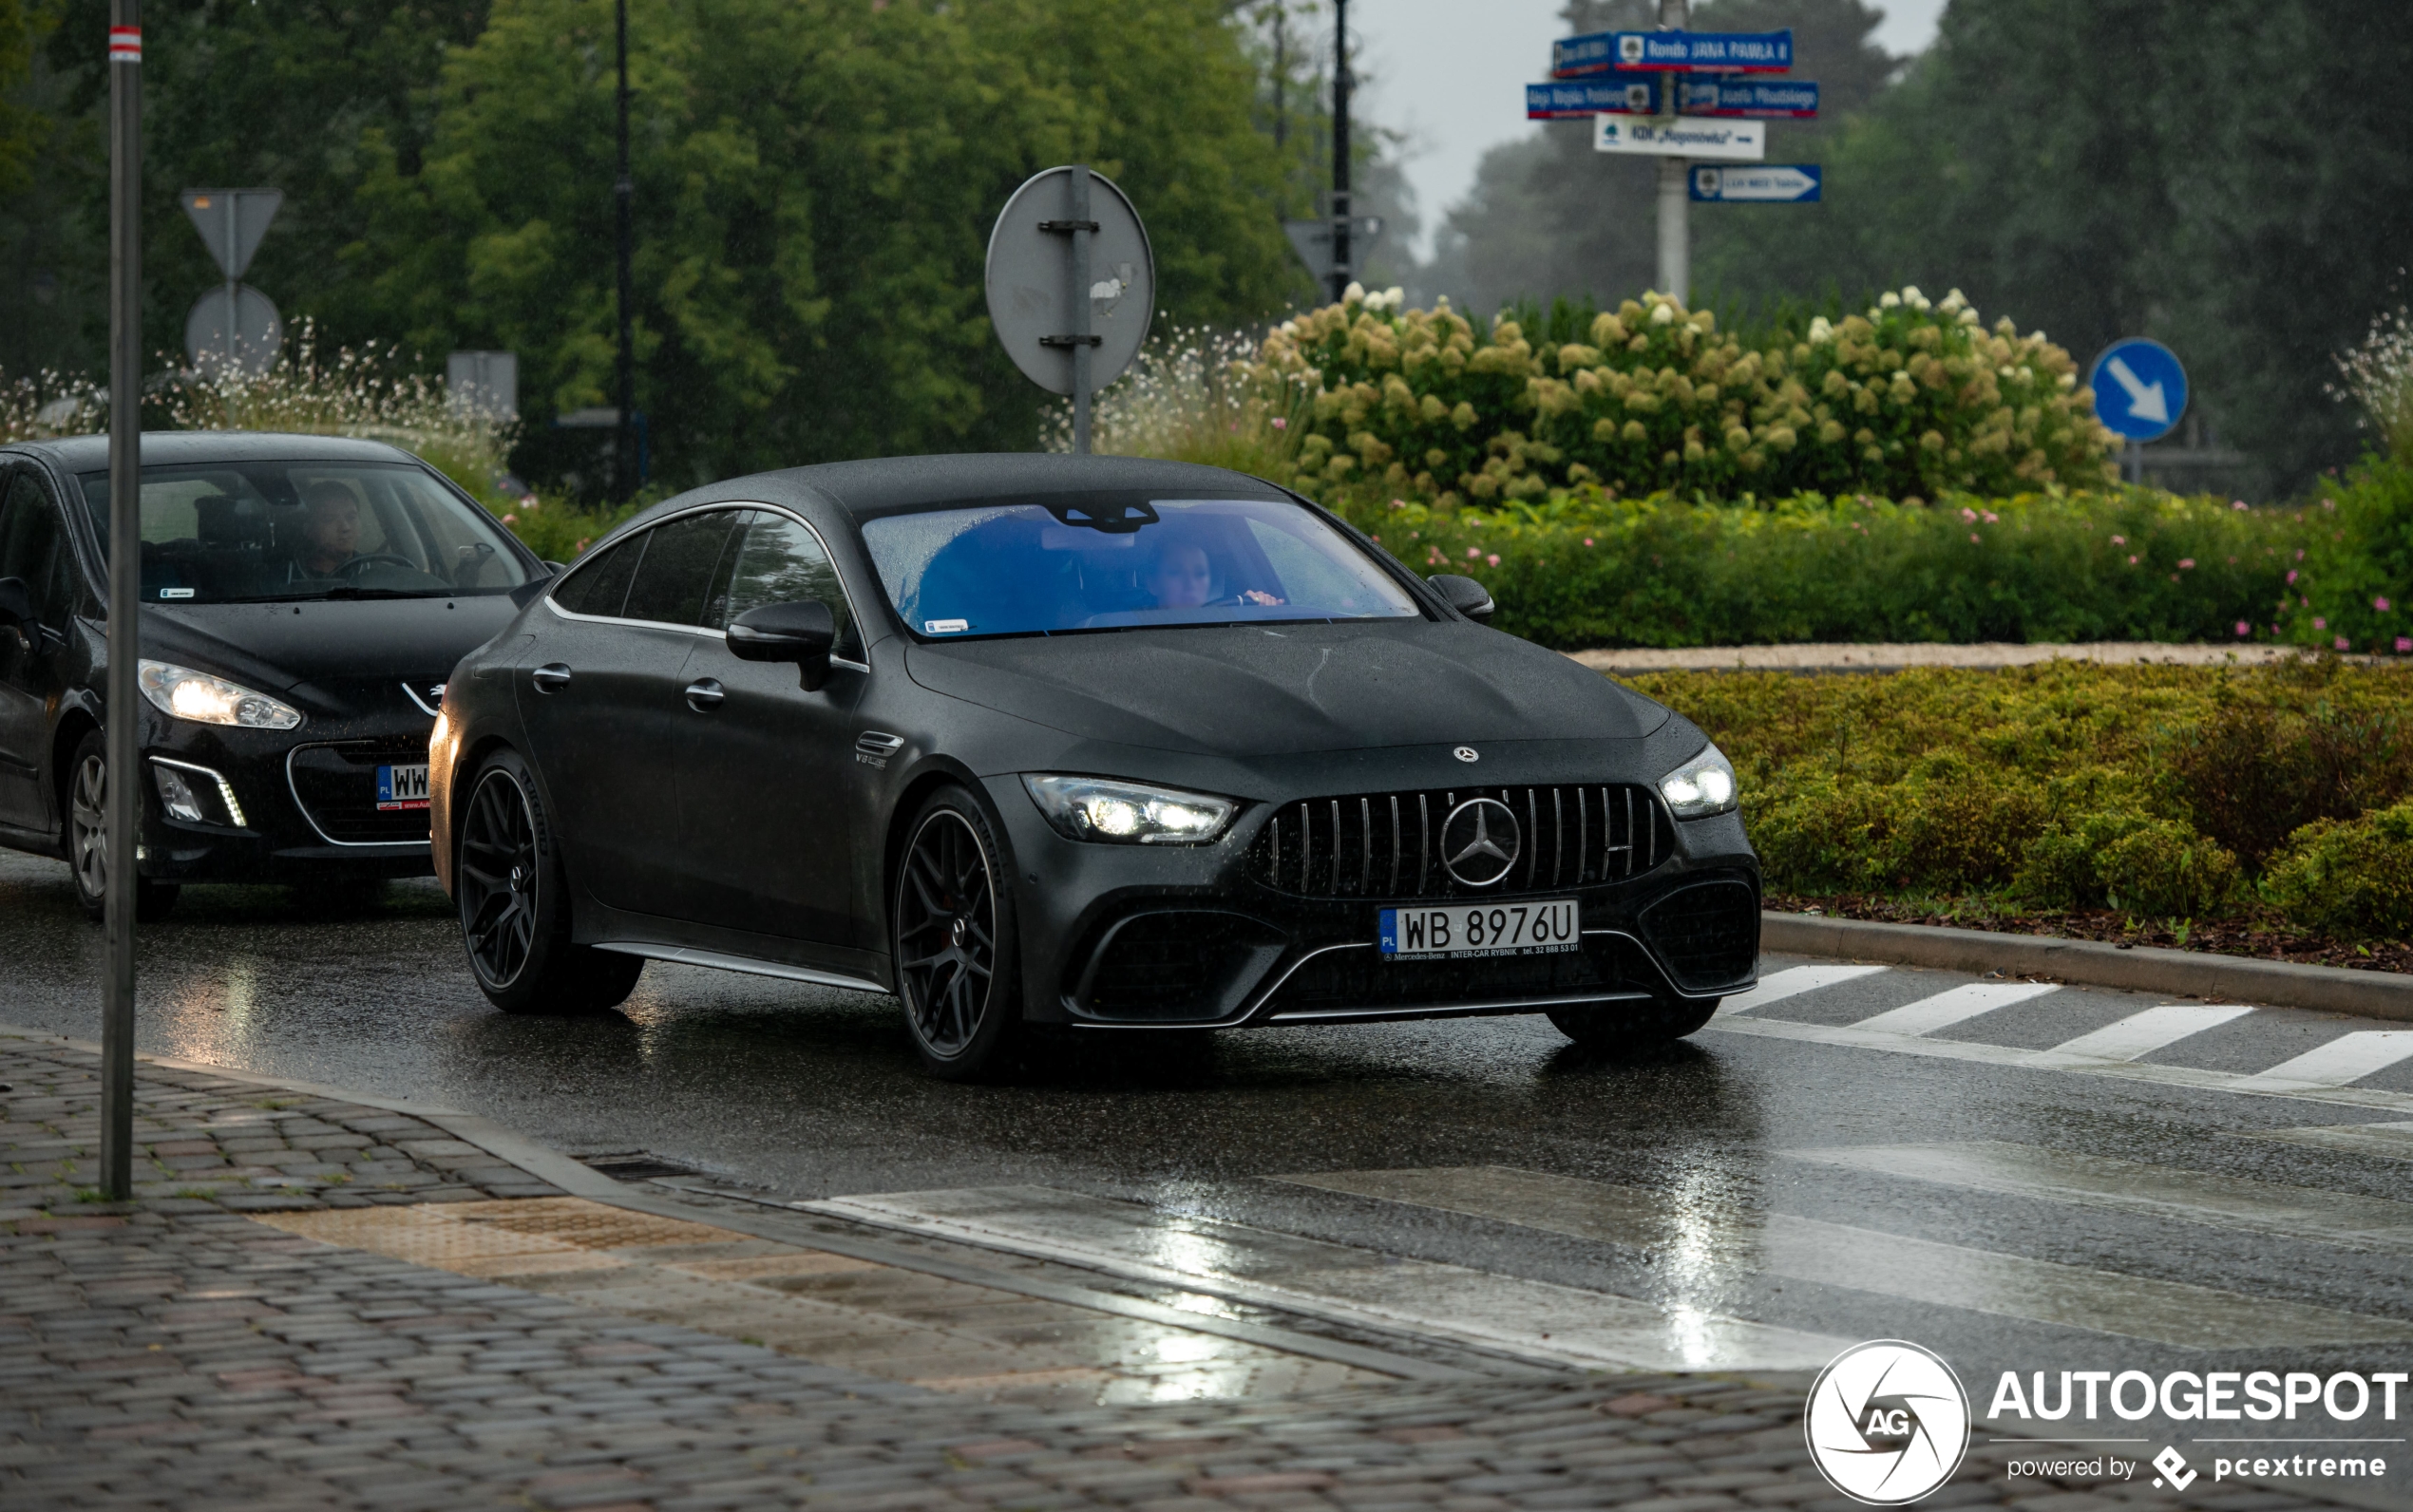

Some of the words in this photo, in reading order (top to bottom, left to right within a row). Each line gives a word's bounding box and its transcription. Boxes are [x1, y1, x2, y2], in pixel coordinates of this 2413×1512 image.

[1647, 39, 1688, 58] Rondo
[1691, 42, 1726, 59] JANA
[1778, 44, 1787, 60] II
[393, 767, 428, 796] WW
[1405, 911, 1451, 949] WB
[1466, 904, 1571, 946] 8976U
[1382, 936, 1396, 947] PL
[1394, 952, 1445, 960] Mercedes-Benz
[1451, 950, 1490, 959] INTER-CAR
[1491, 948, 1517, 957] RYBNIK
[1523, 946, 1534, 955] tel.
[1535, 946, 1545, 954] 32
[1546, 945, 1559, 954] 888
[1560, 944, 1569, 953] 53
[1569, 943, 1578, 952] 01
